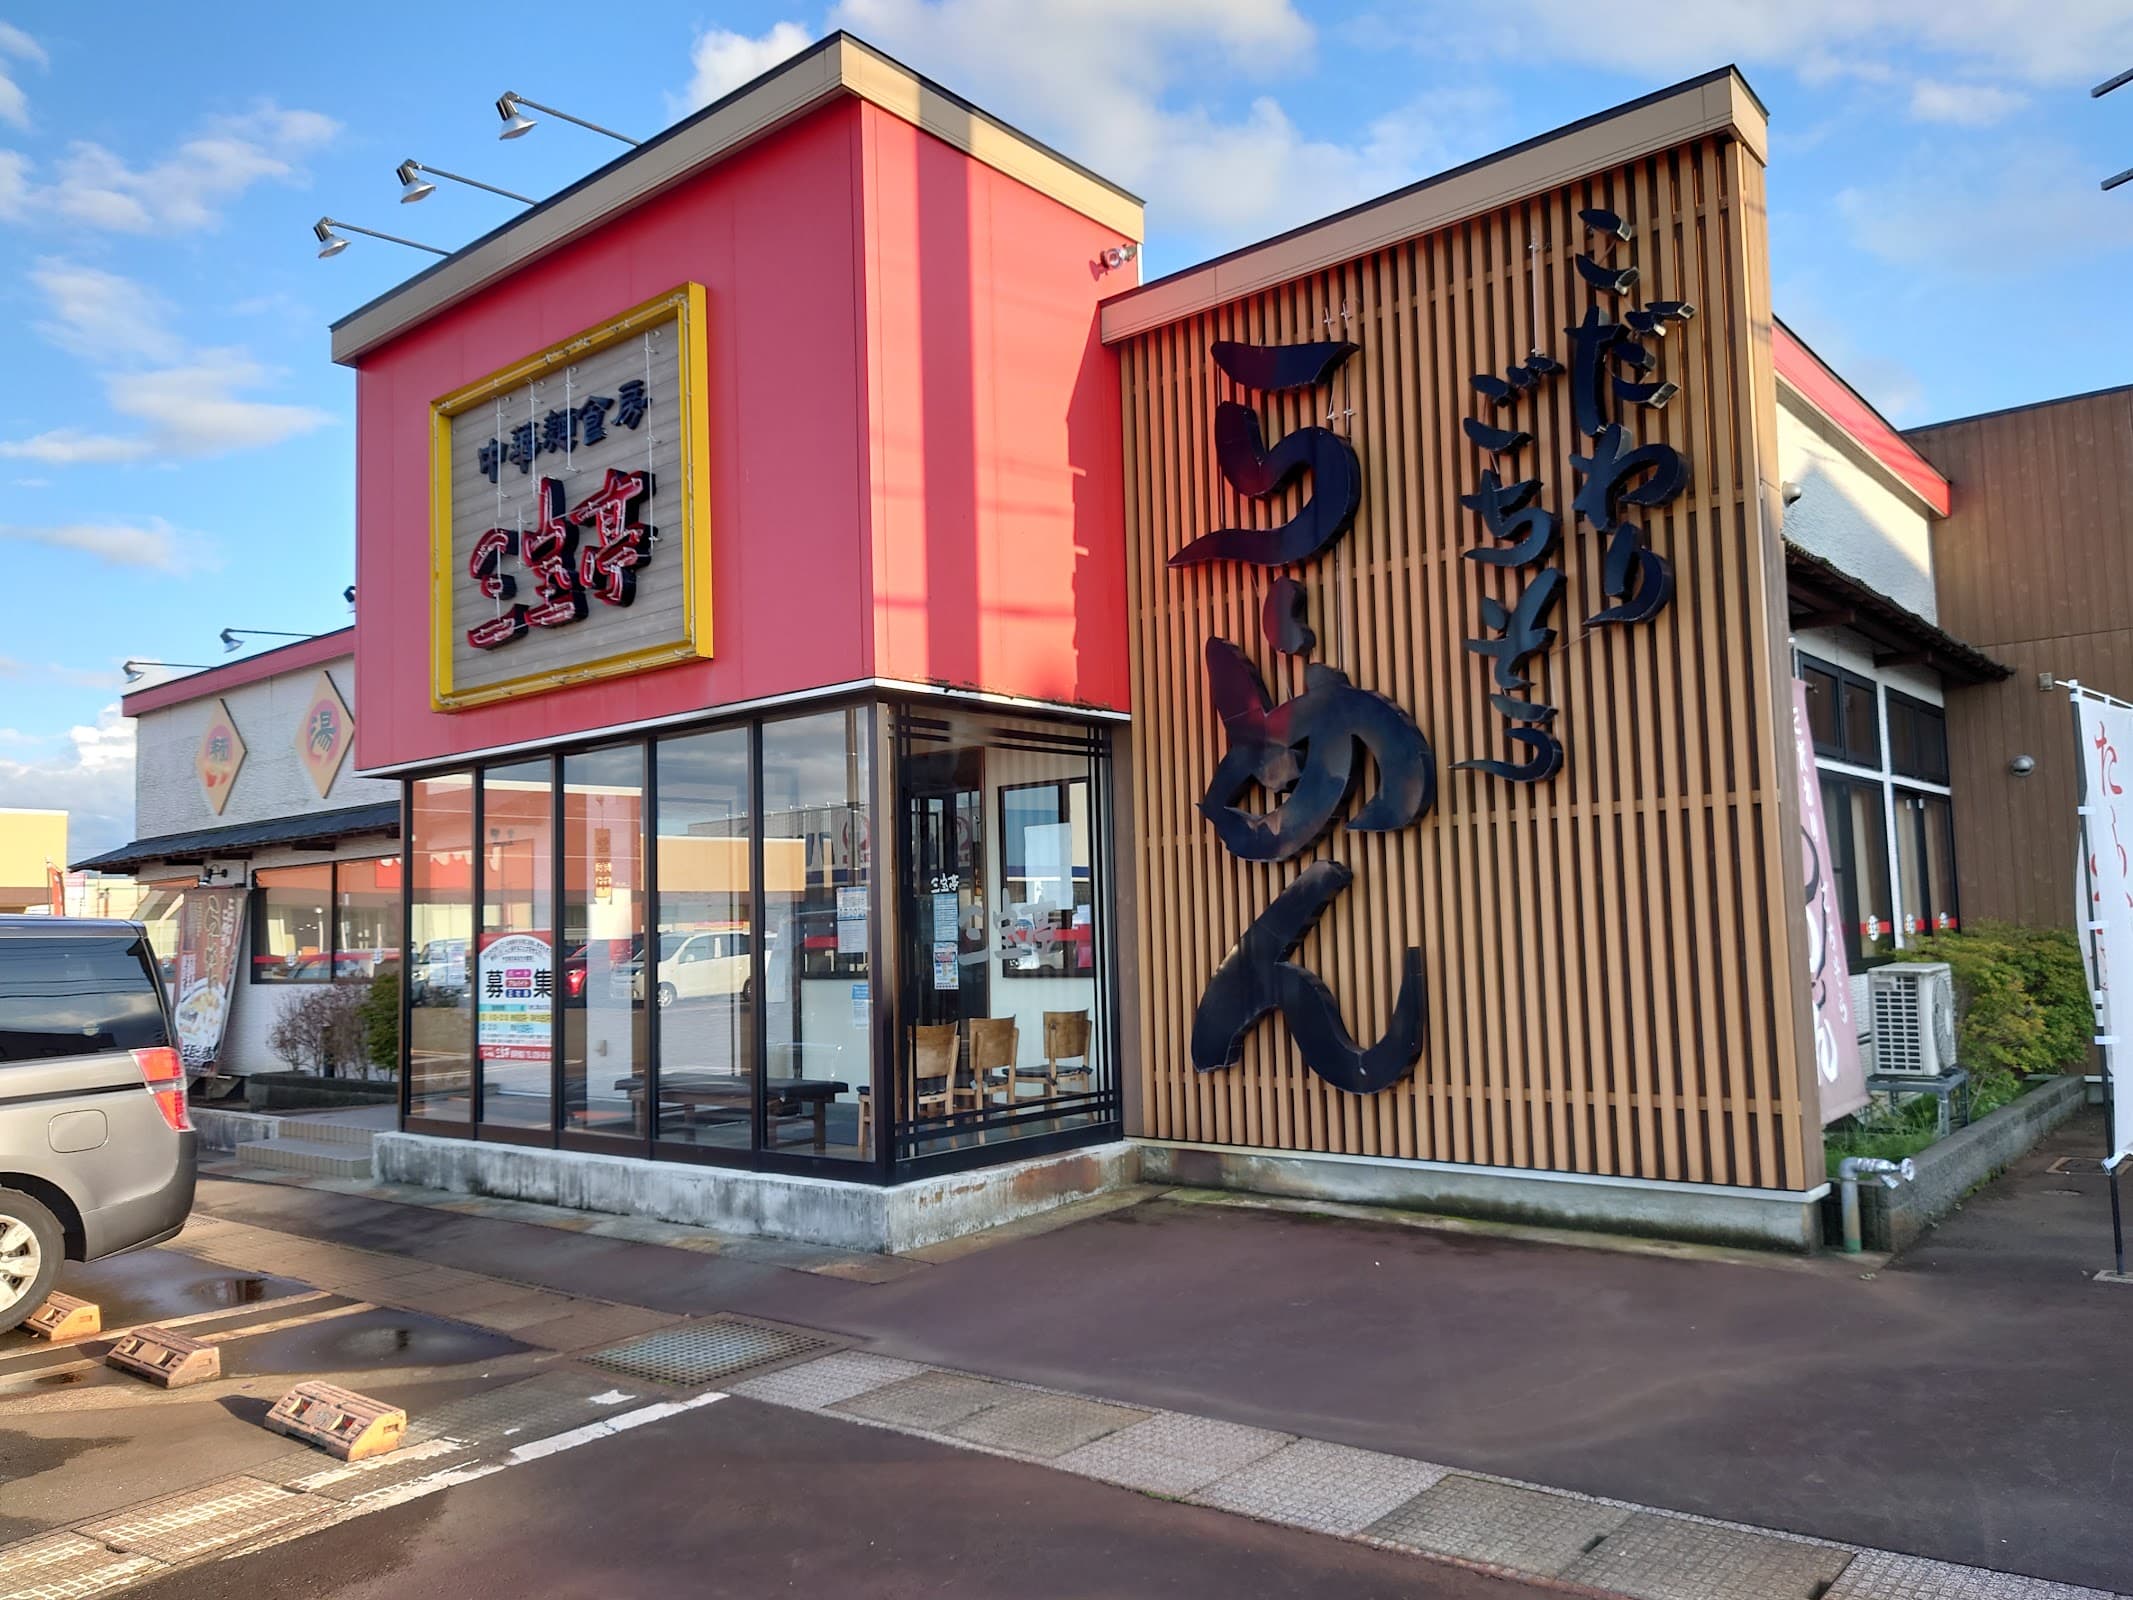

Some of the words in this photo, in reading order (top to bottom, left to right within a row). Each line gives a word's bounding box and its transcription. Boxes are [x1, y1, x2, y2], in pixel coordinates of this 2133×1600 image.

[1448, 356, 1567, 783] ごちそう
[1563, 208, 1696, 628] こだわり
[1166, 340, 1436, 1095] らーめん
